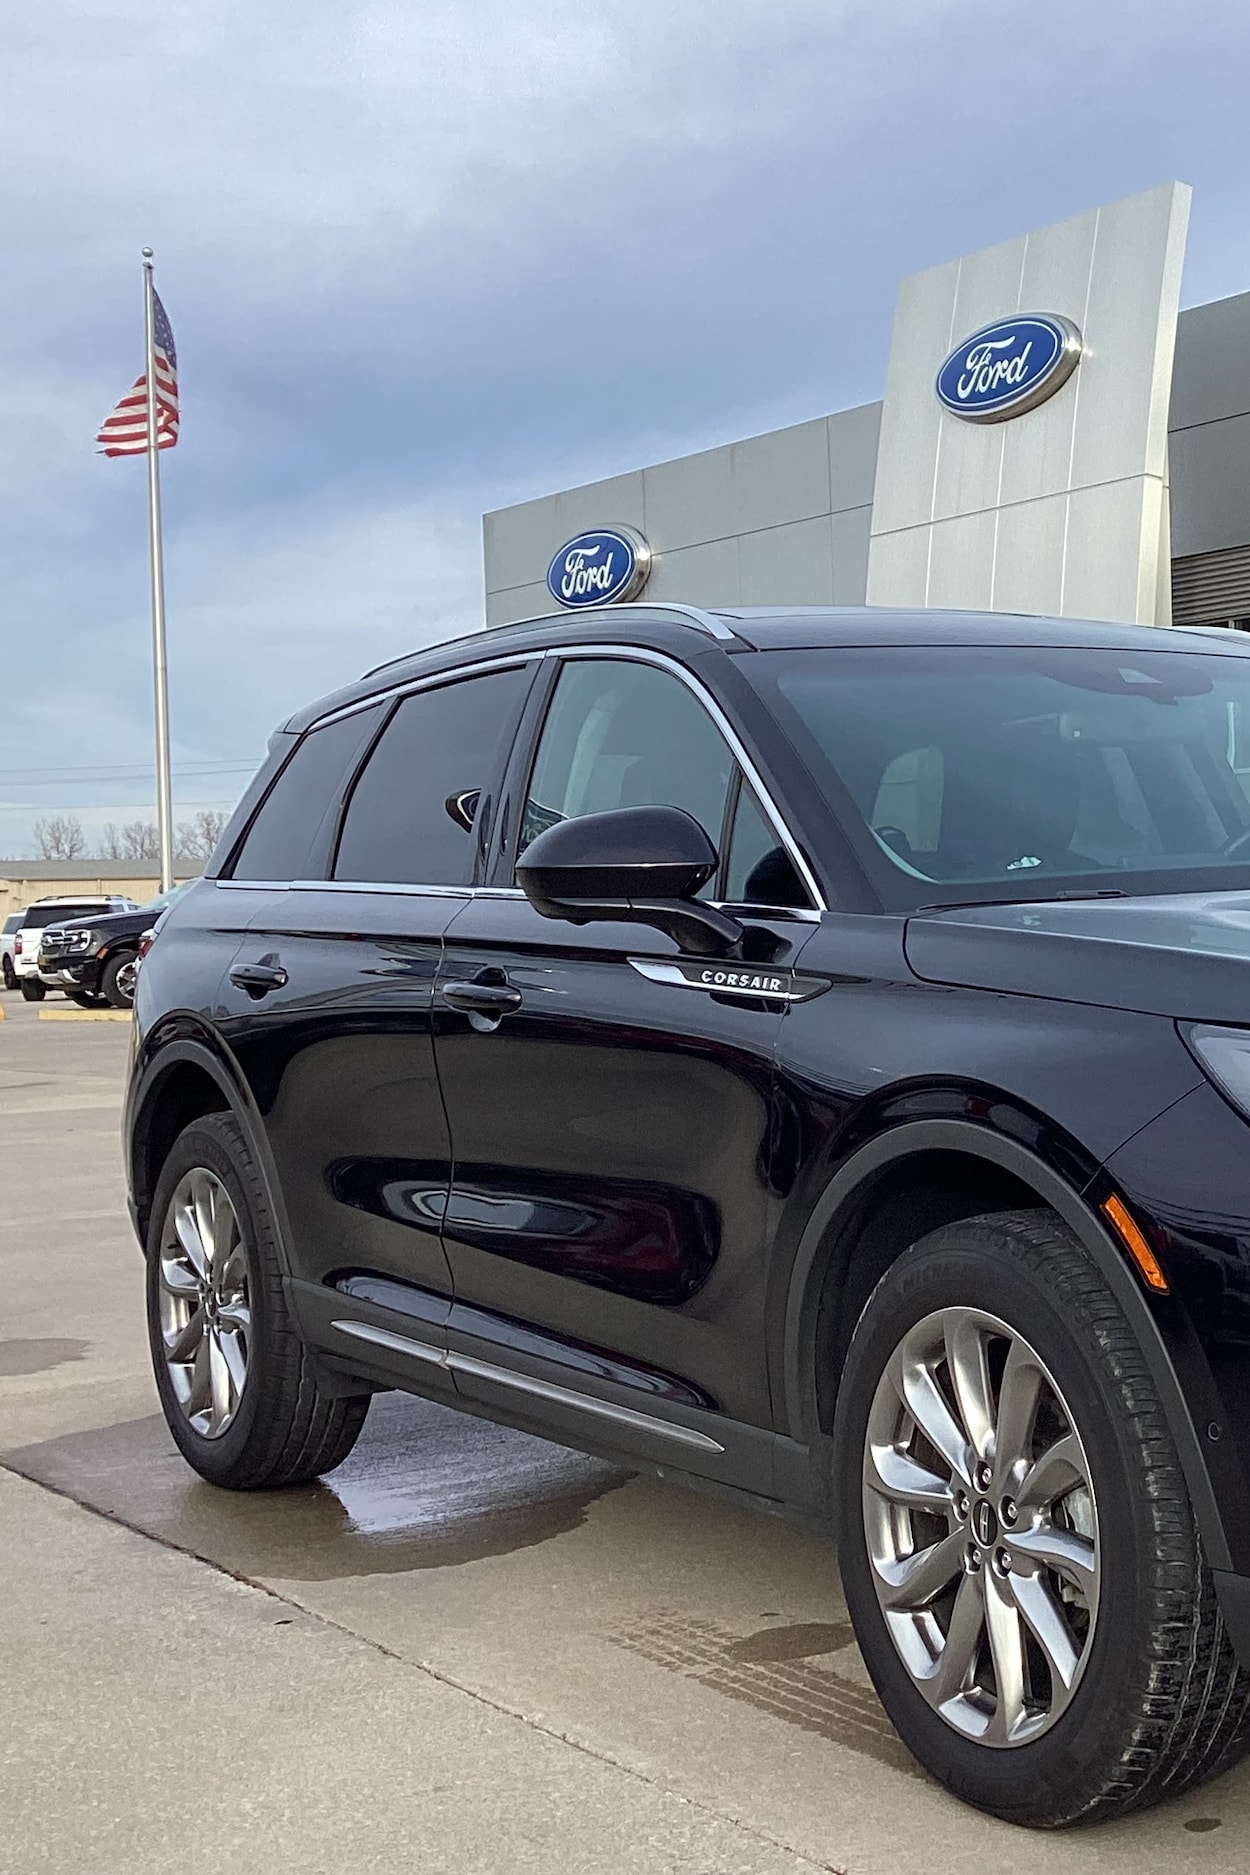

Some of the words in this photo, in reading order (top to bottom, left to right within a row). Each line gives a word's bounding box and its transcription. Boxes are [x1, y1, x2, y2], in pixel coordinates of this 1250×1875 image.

[957, 335, 1032, 399] Ford
[561, 545, 614, 598] Ford
[701, 969, 782, 991] CORSAIR
